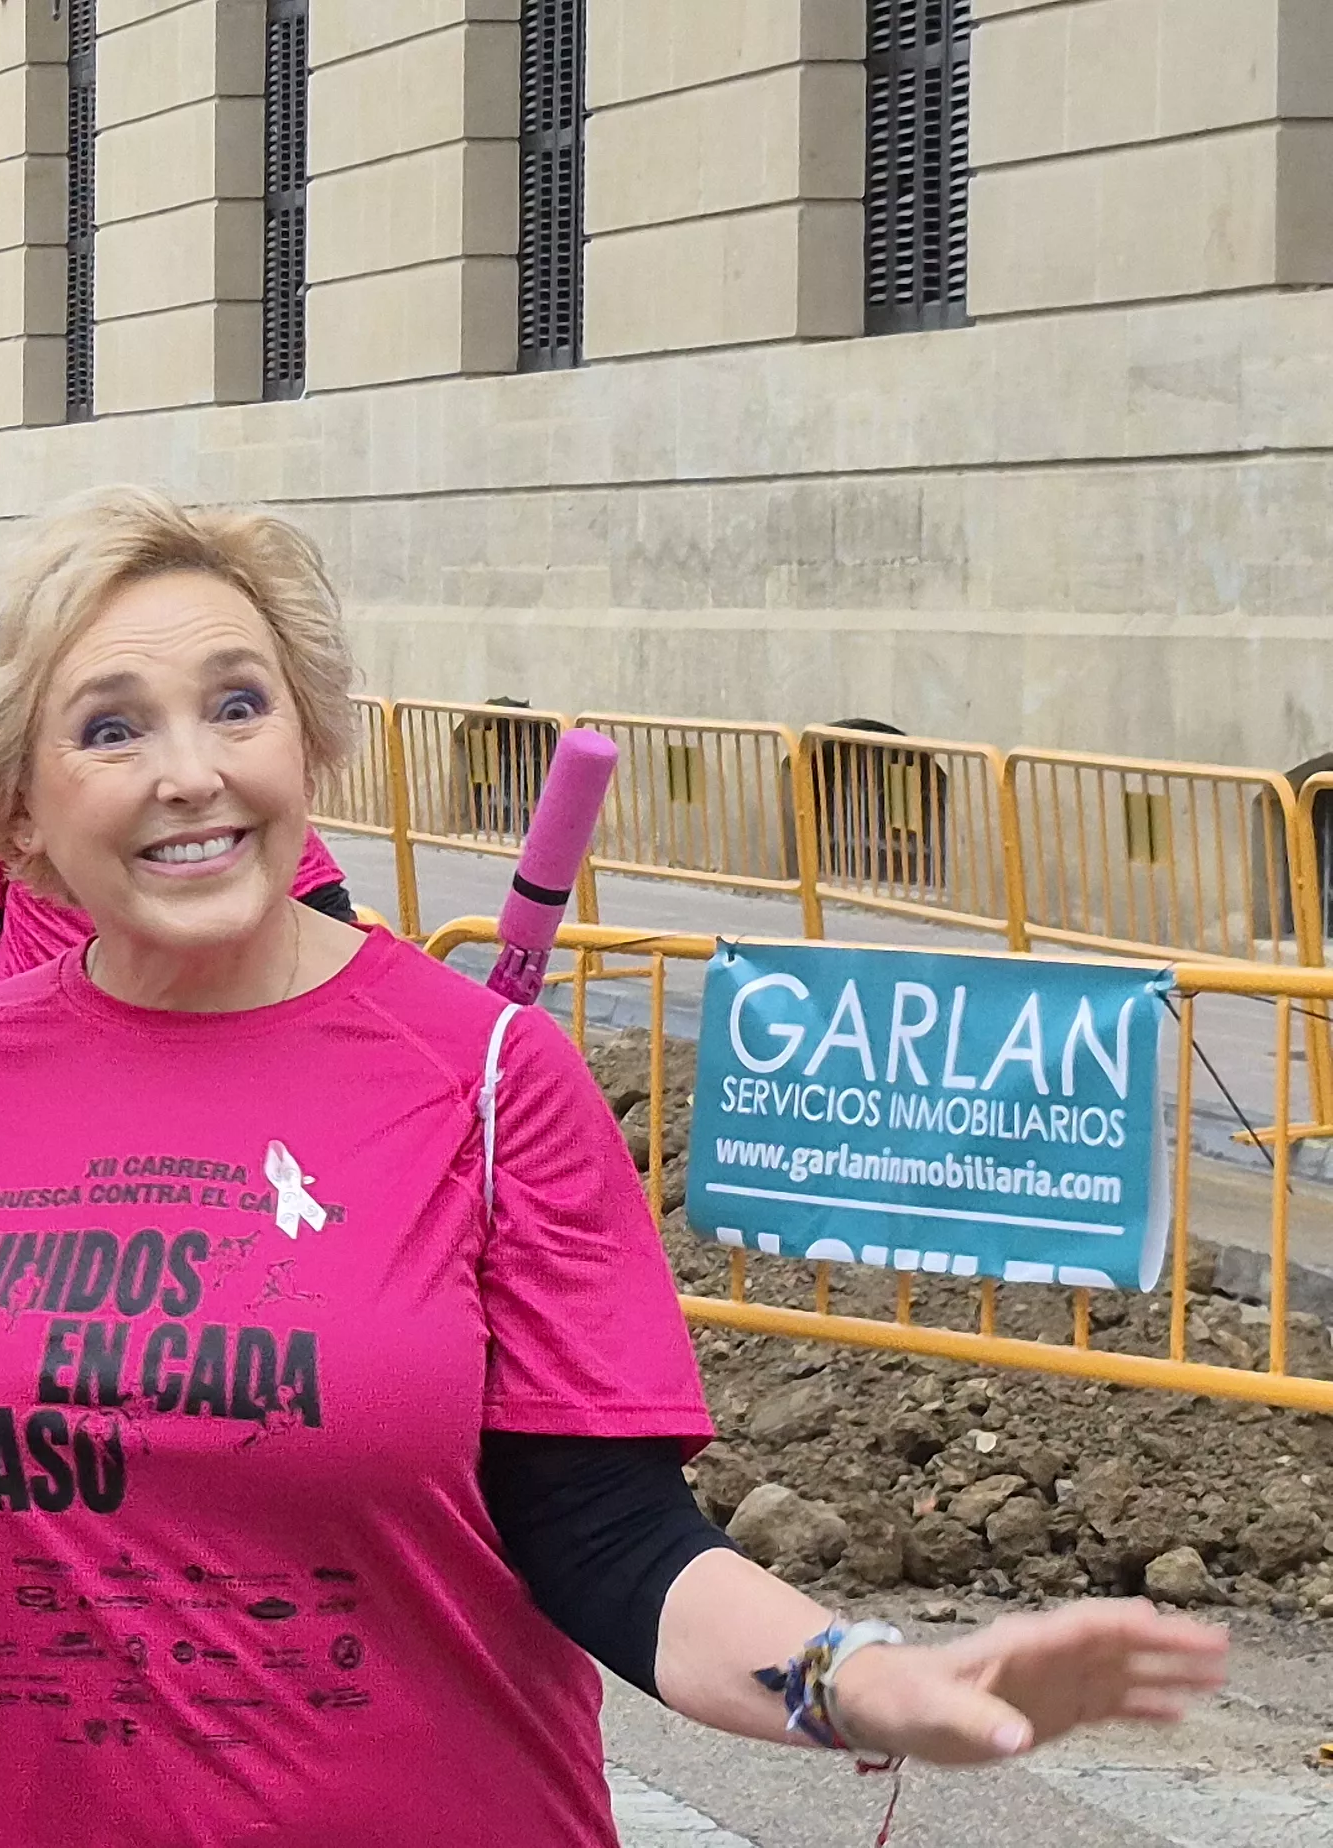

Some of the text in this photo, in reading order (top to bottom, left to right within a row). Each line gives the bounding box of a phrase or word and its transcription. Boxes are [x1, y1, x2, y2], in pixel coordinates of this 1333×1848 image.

[729, 972, 1135, 1100] GARLAN
[720, 1075, 1127, 1150] SERVICIOS INMOBILIARIOS
[85, 1154, 248, 1186] XII CARRERA
[88, 1182, 192, 1206] CONTRA
[199, 1186, 231, 1209] EL
[715, 1137, 1121, 1204] www.garlaninmobiliaria.com
[38, 1318, 323, 1429] EN CADA
